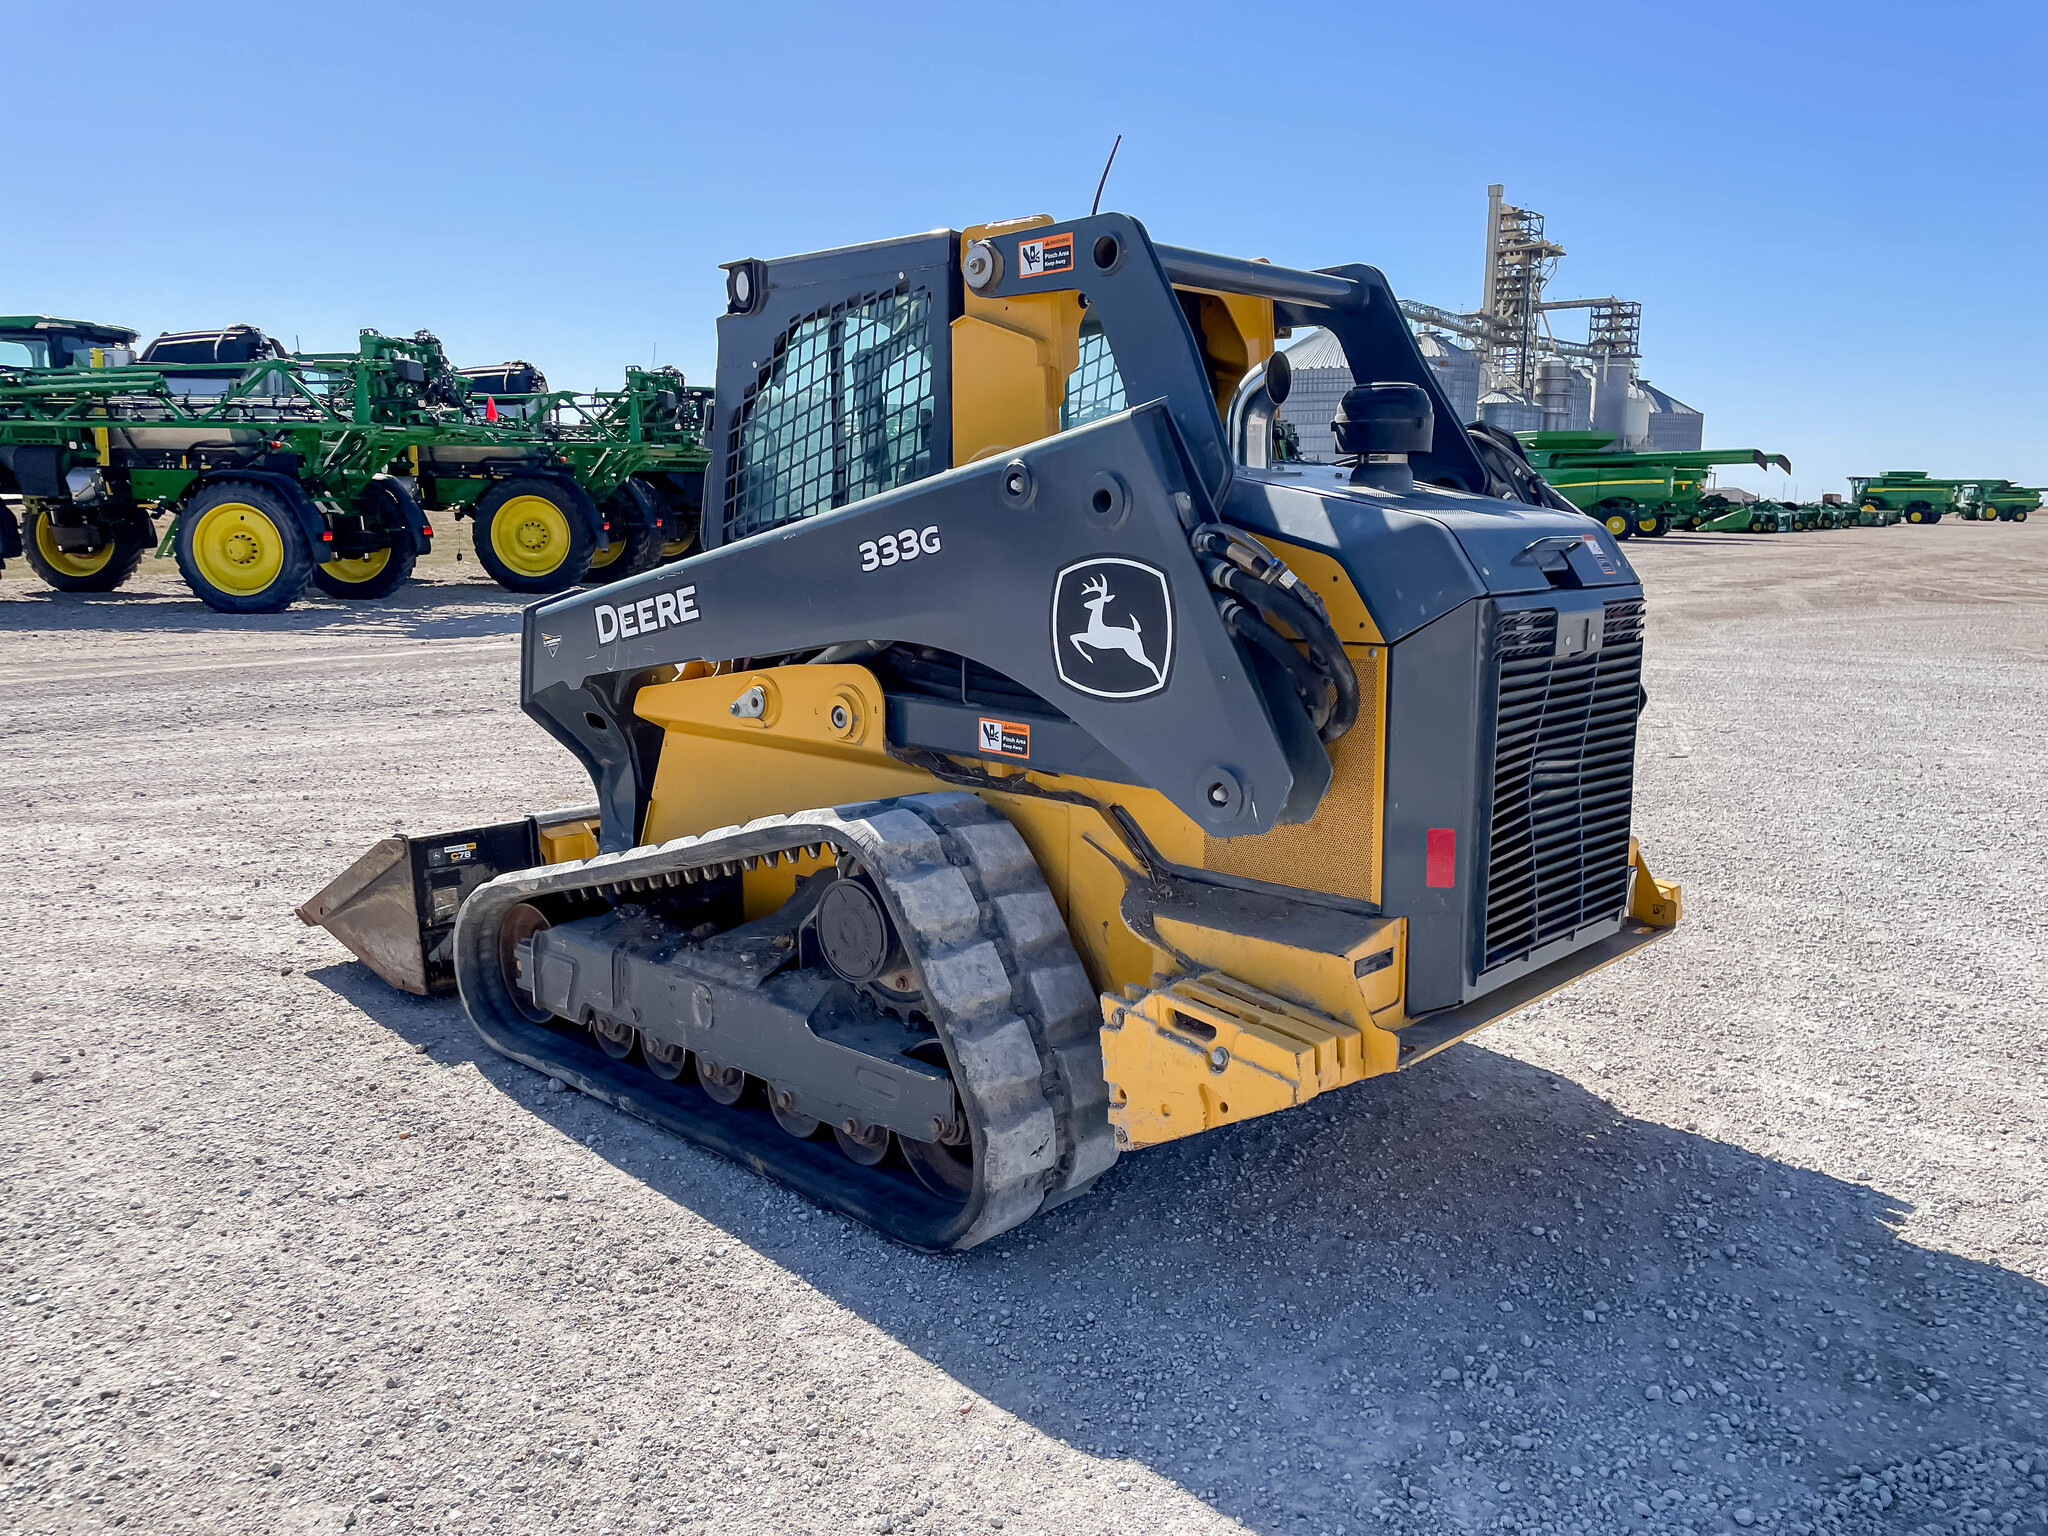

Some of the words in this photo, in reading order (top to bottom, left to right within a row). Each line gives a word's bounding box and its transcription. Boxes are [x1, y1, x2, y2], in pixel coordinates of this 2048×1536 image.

[1045, 252, 1058, 260] Pinch
[859, 526, 941, 571] 333G
[595, 585, 700, 644] DEERE
